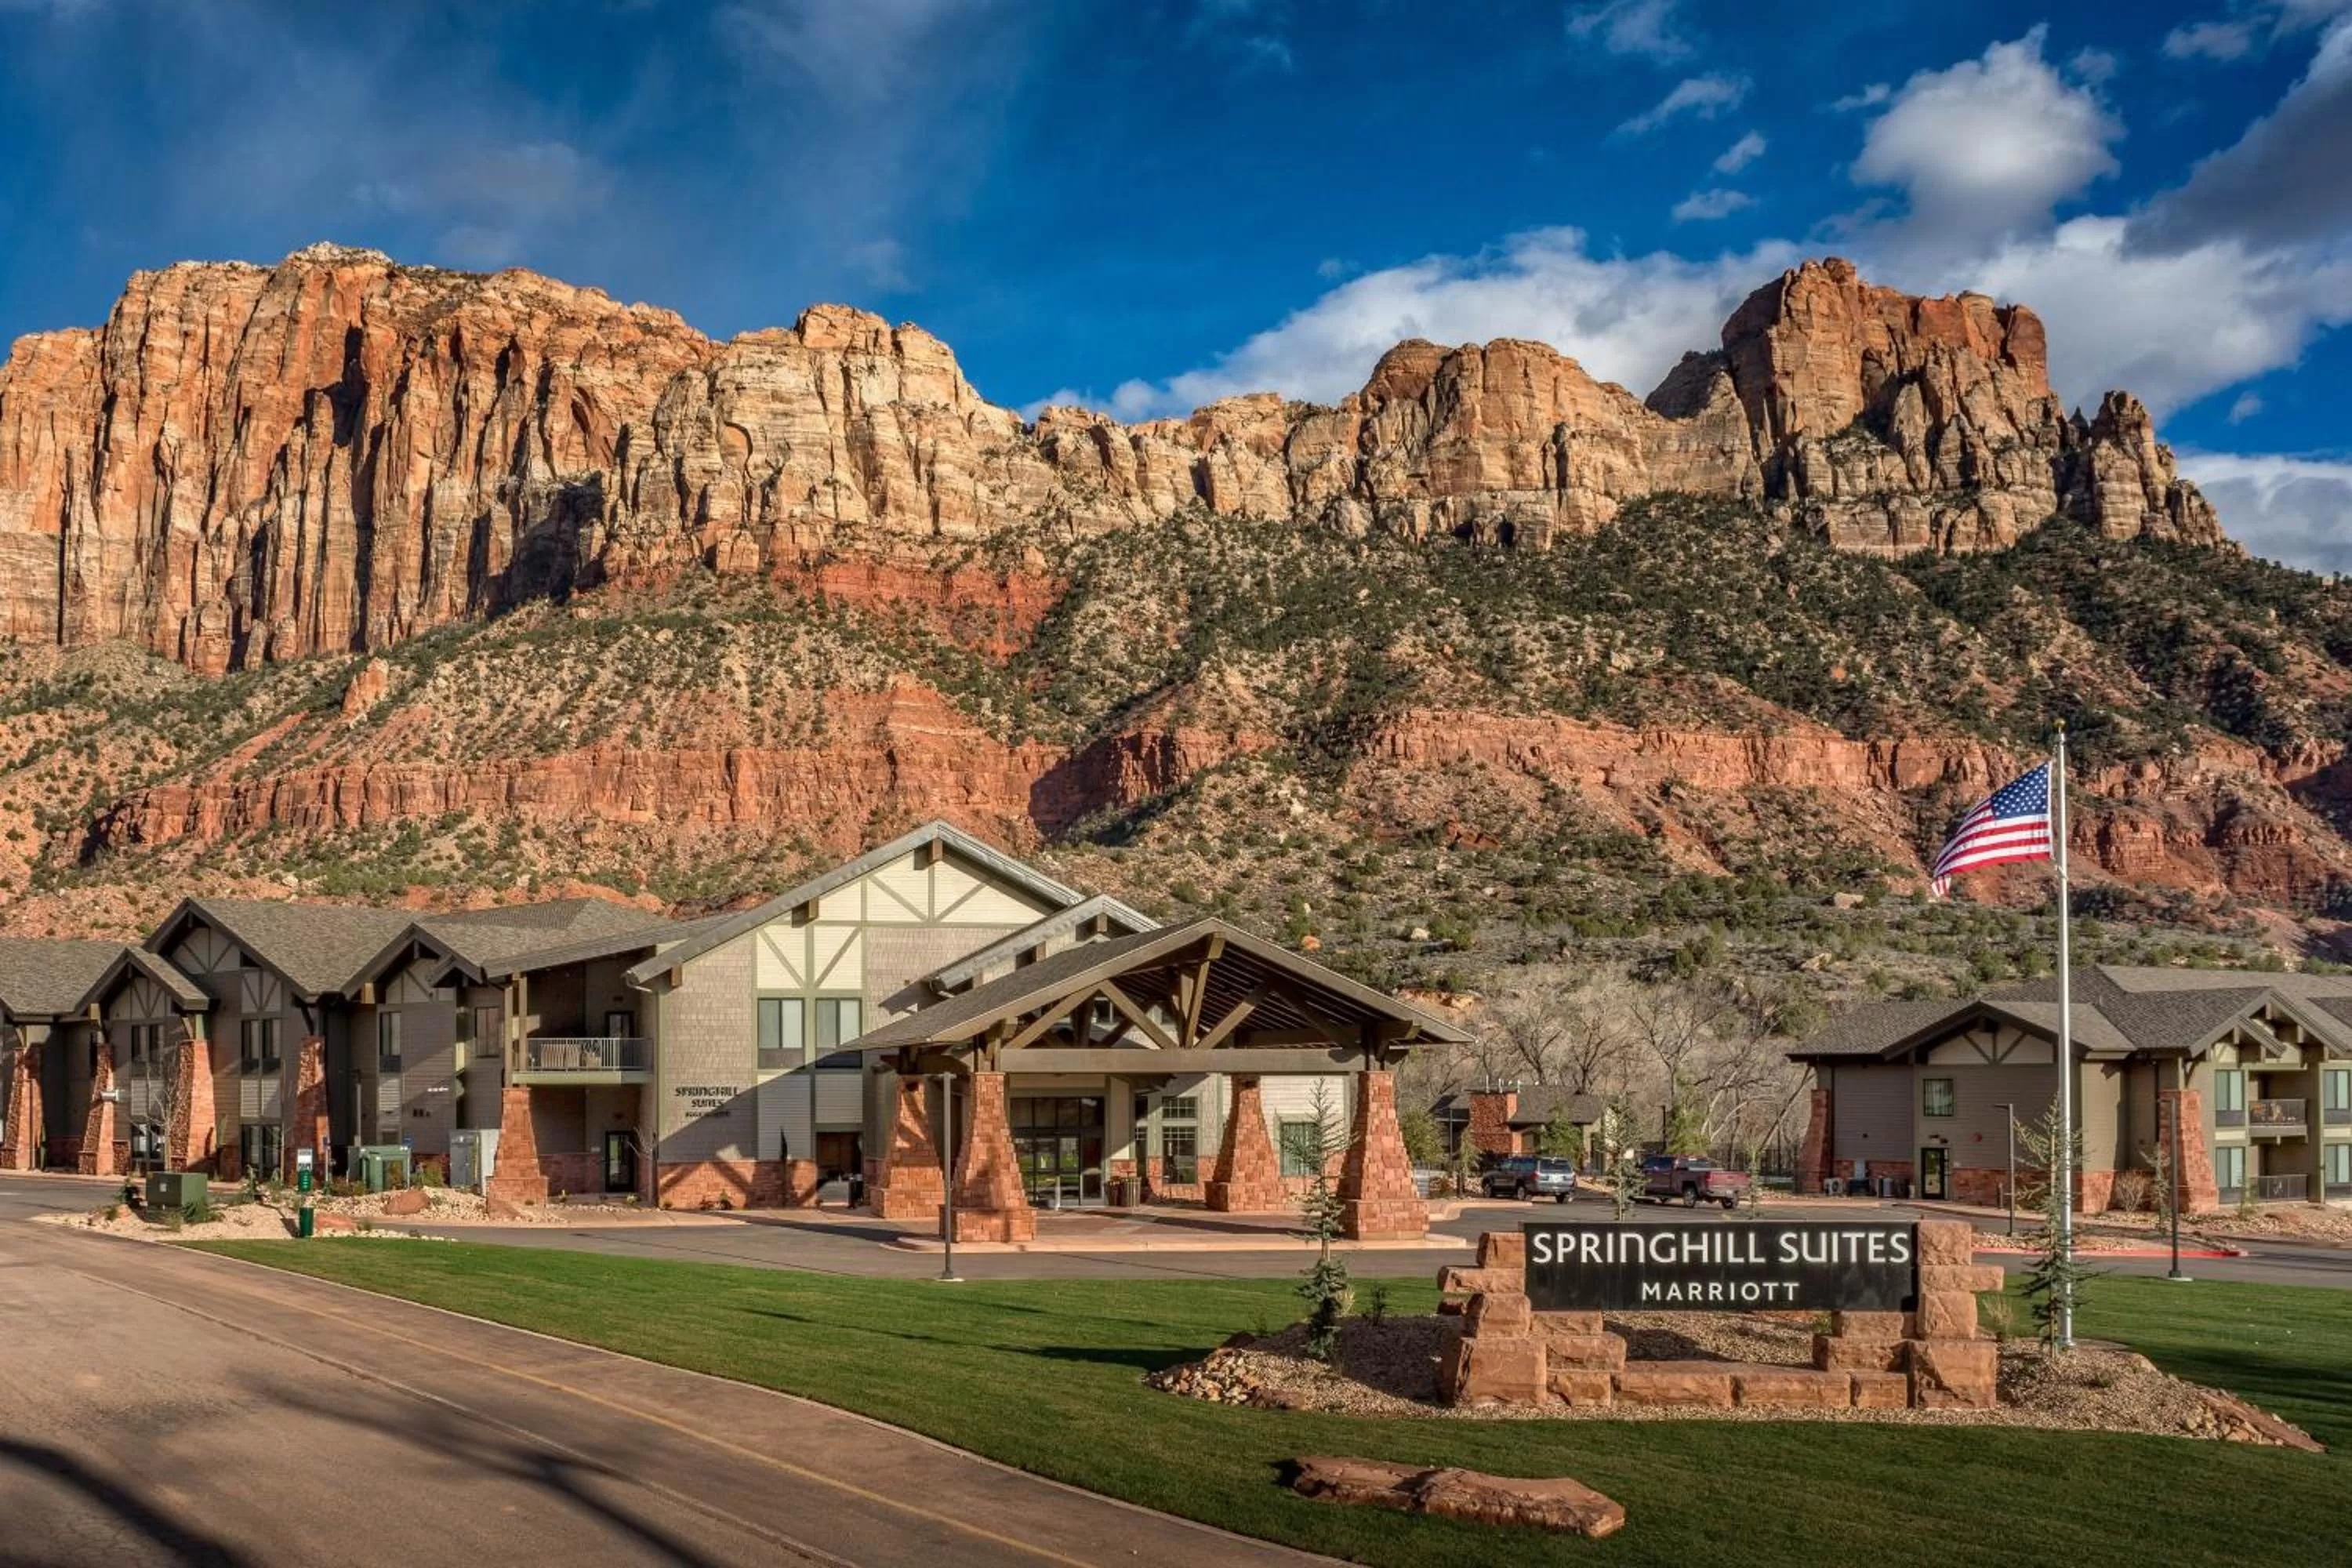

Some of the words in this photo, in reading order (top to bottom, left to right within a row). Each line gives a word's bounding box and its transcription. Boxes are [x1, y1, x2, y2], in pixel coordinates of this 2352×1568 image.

[1532, 1232, 1766, 1264] SPRINGHILL
[1779, 1232, 1910, 1264] SUITES
[1642, 1282, 1799, 1301] MARRIOTT
